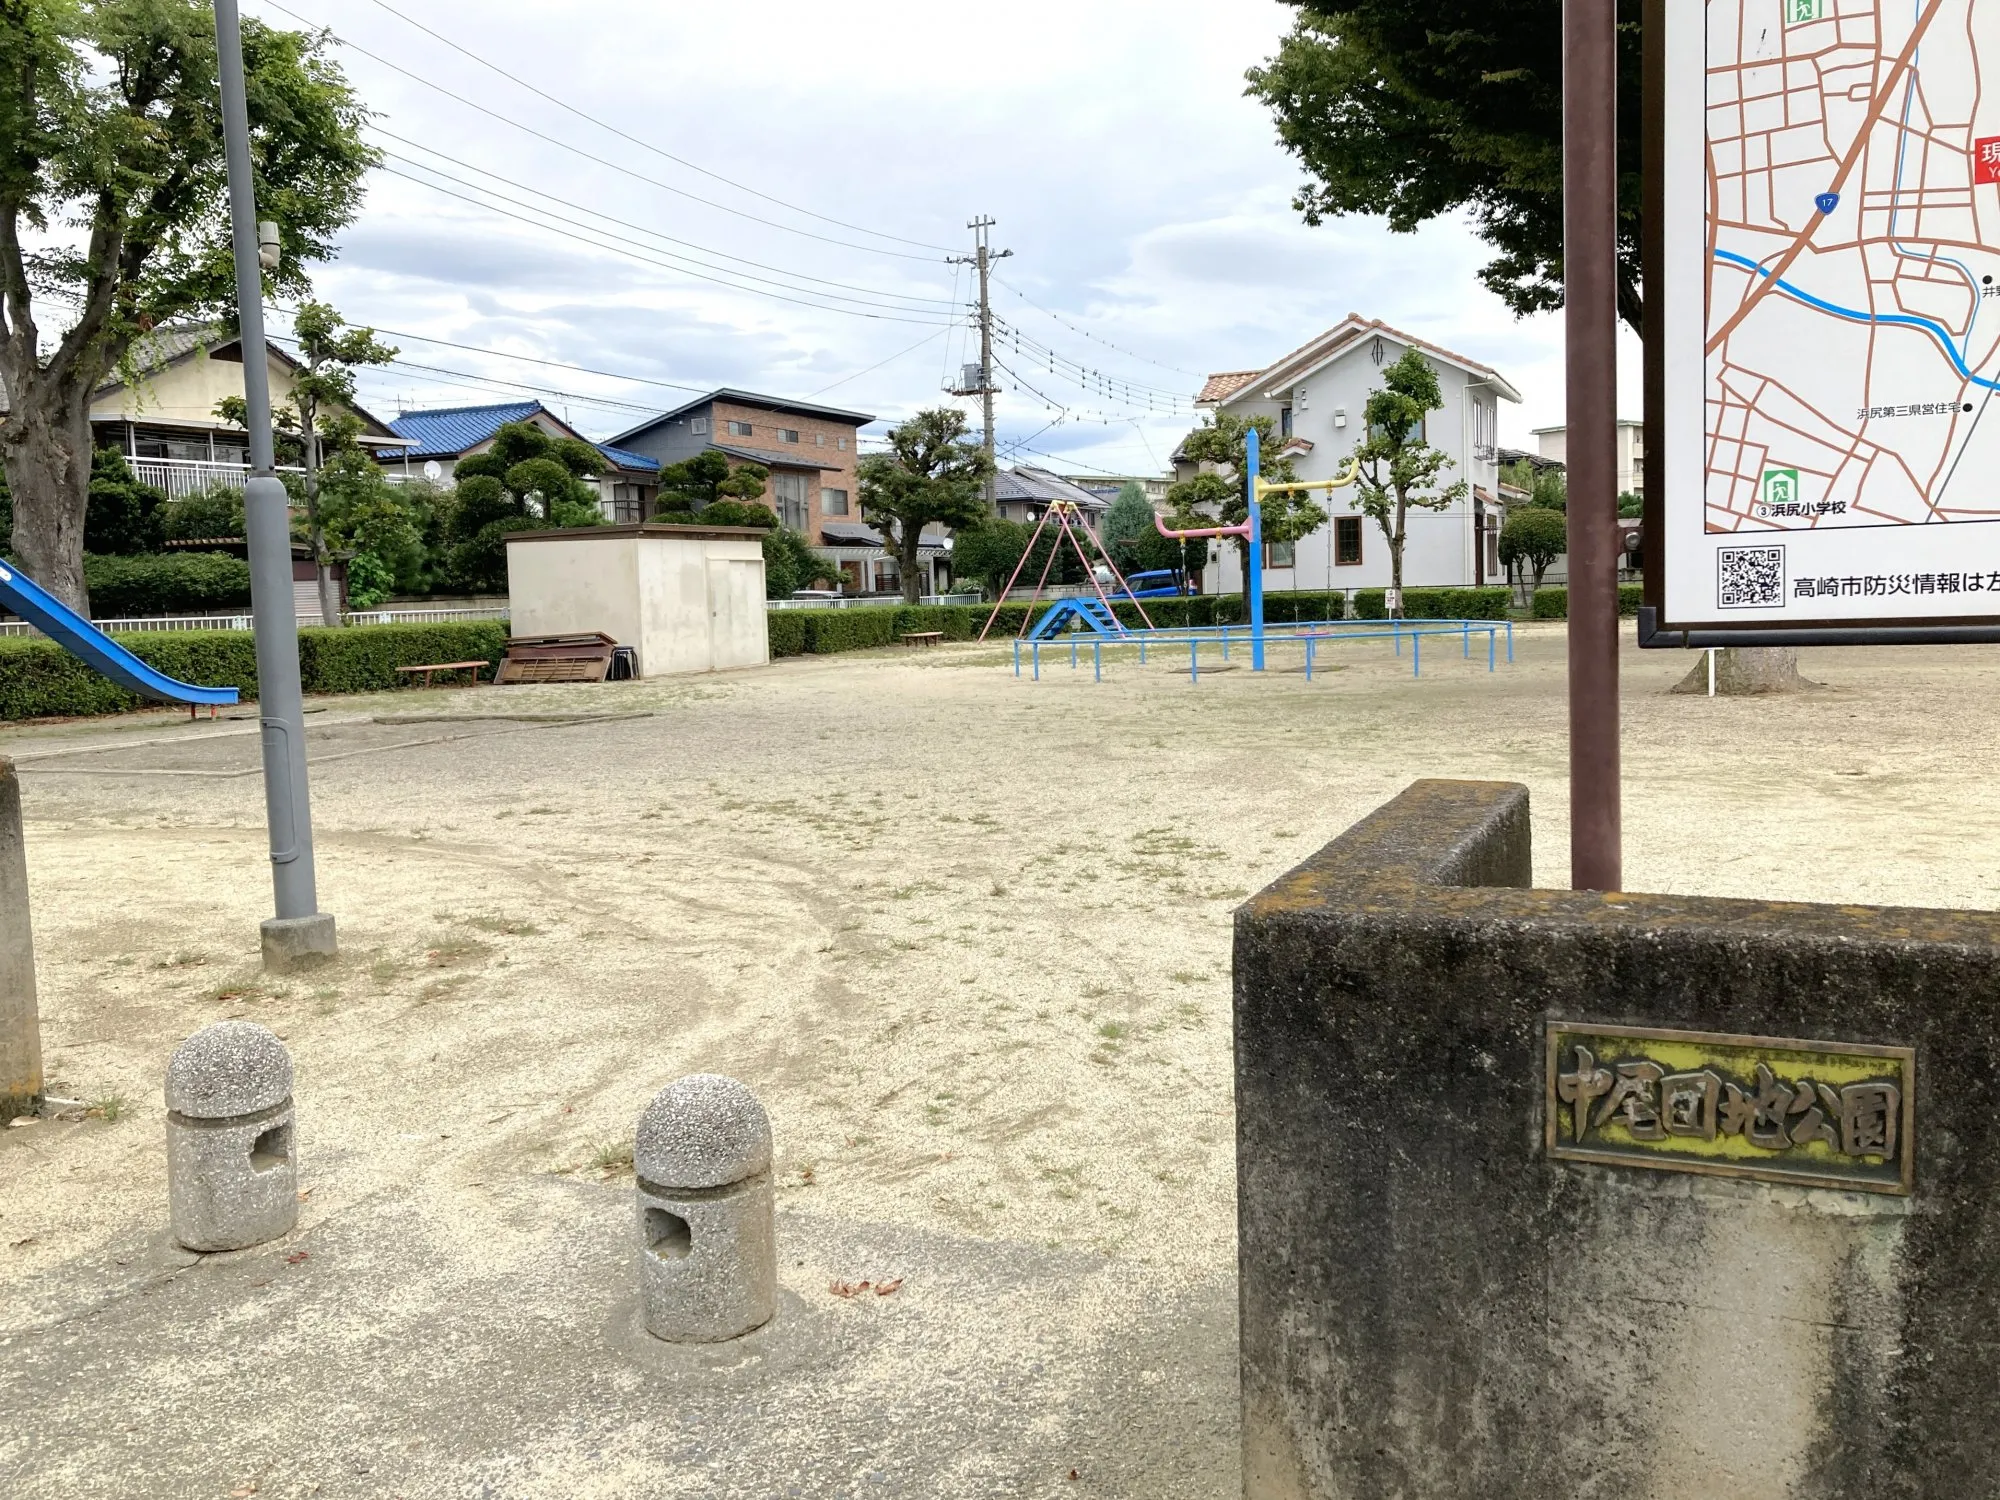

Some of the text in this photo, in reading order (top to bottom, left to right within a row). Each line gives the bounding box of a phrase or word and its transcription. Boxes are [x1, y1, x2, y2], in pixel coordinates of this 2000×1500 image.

[1822, 198, 1834, 207] 17
[1857, 402, 1961, 420] 浜尻第三県営住宅
[1558, 1045, 1900, 1160] 中尾団地公園
